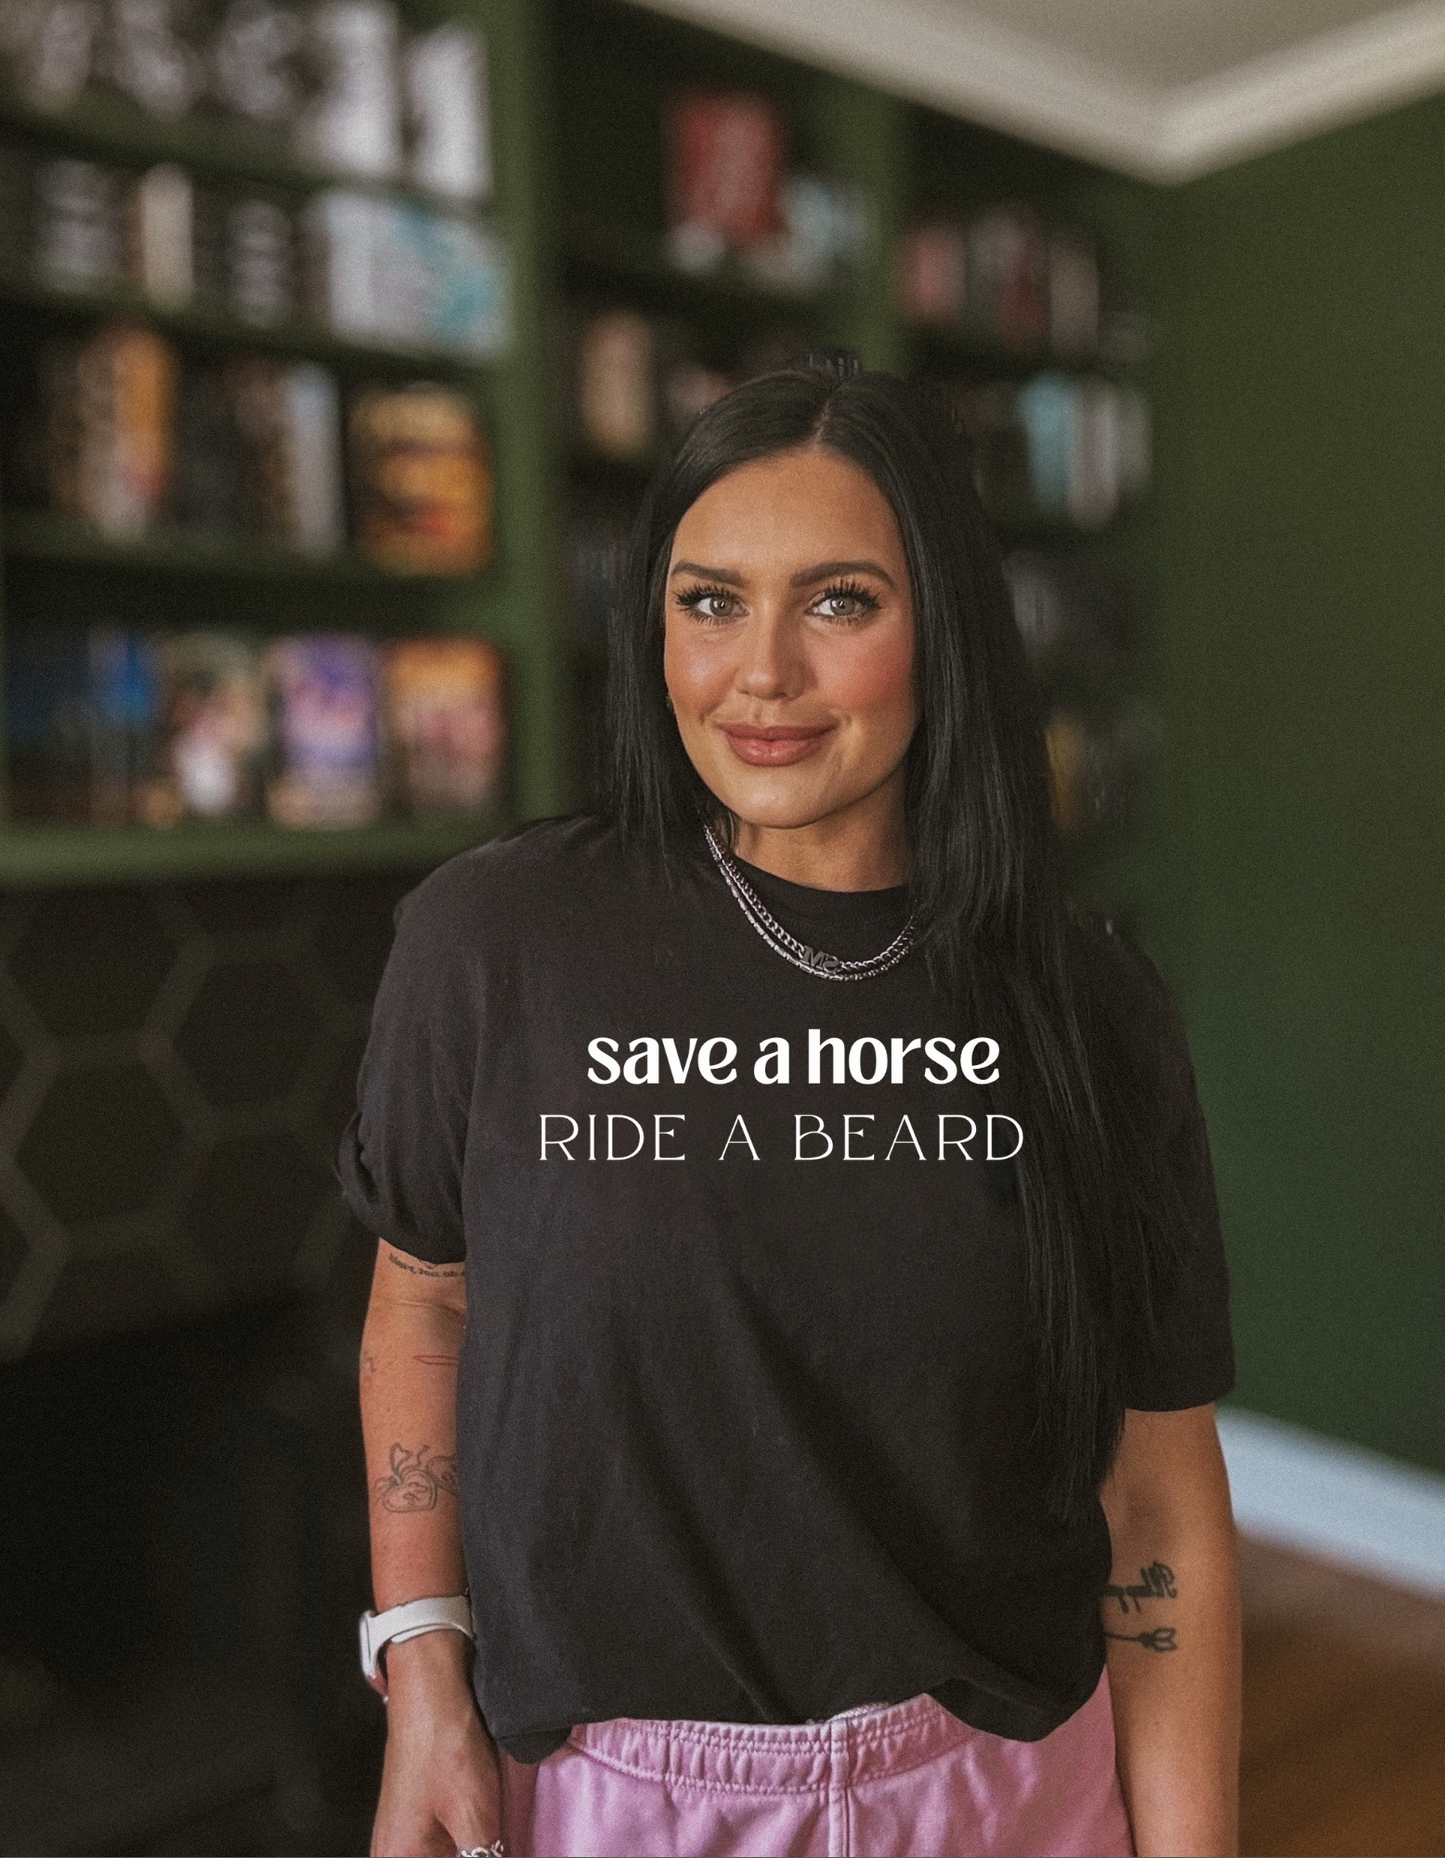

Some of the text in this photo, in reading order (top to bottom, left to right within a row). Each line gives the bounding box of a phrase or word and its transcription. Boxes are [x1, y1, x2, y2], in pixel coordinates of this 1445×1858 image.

[588, 1028, 1000, 1084] save a horse
[539, 1114, 1024, 1161] RIDE A BEARD
